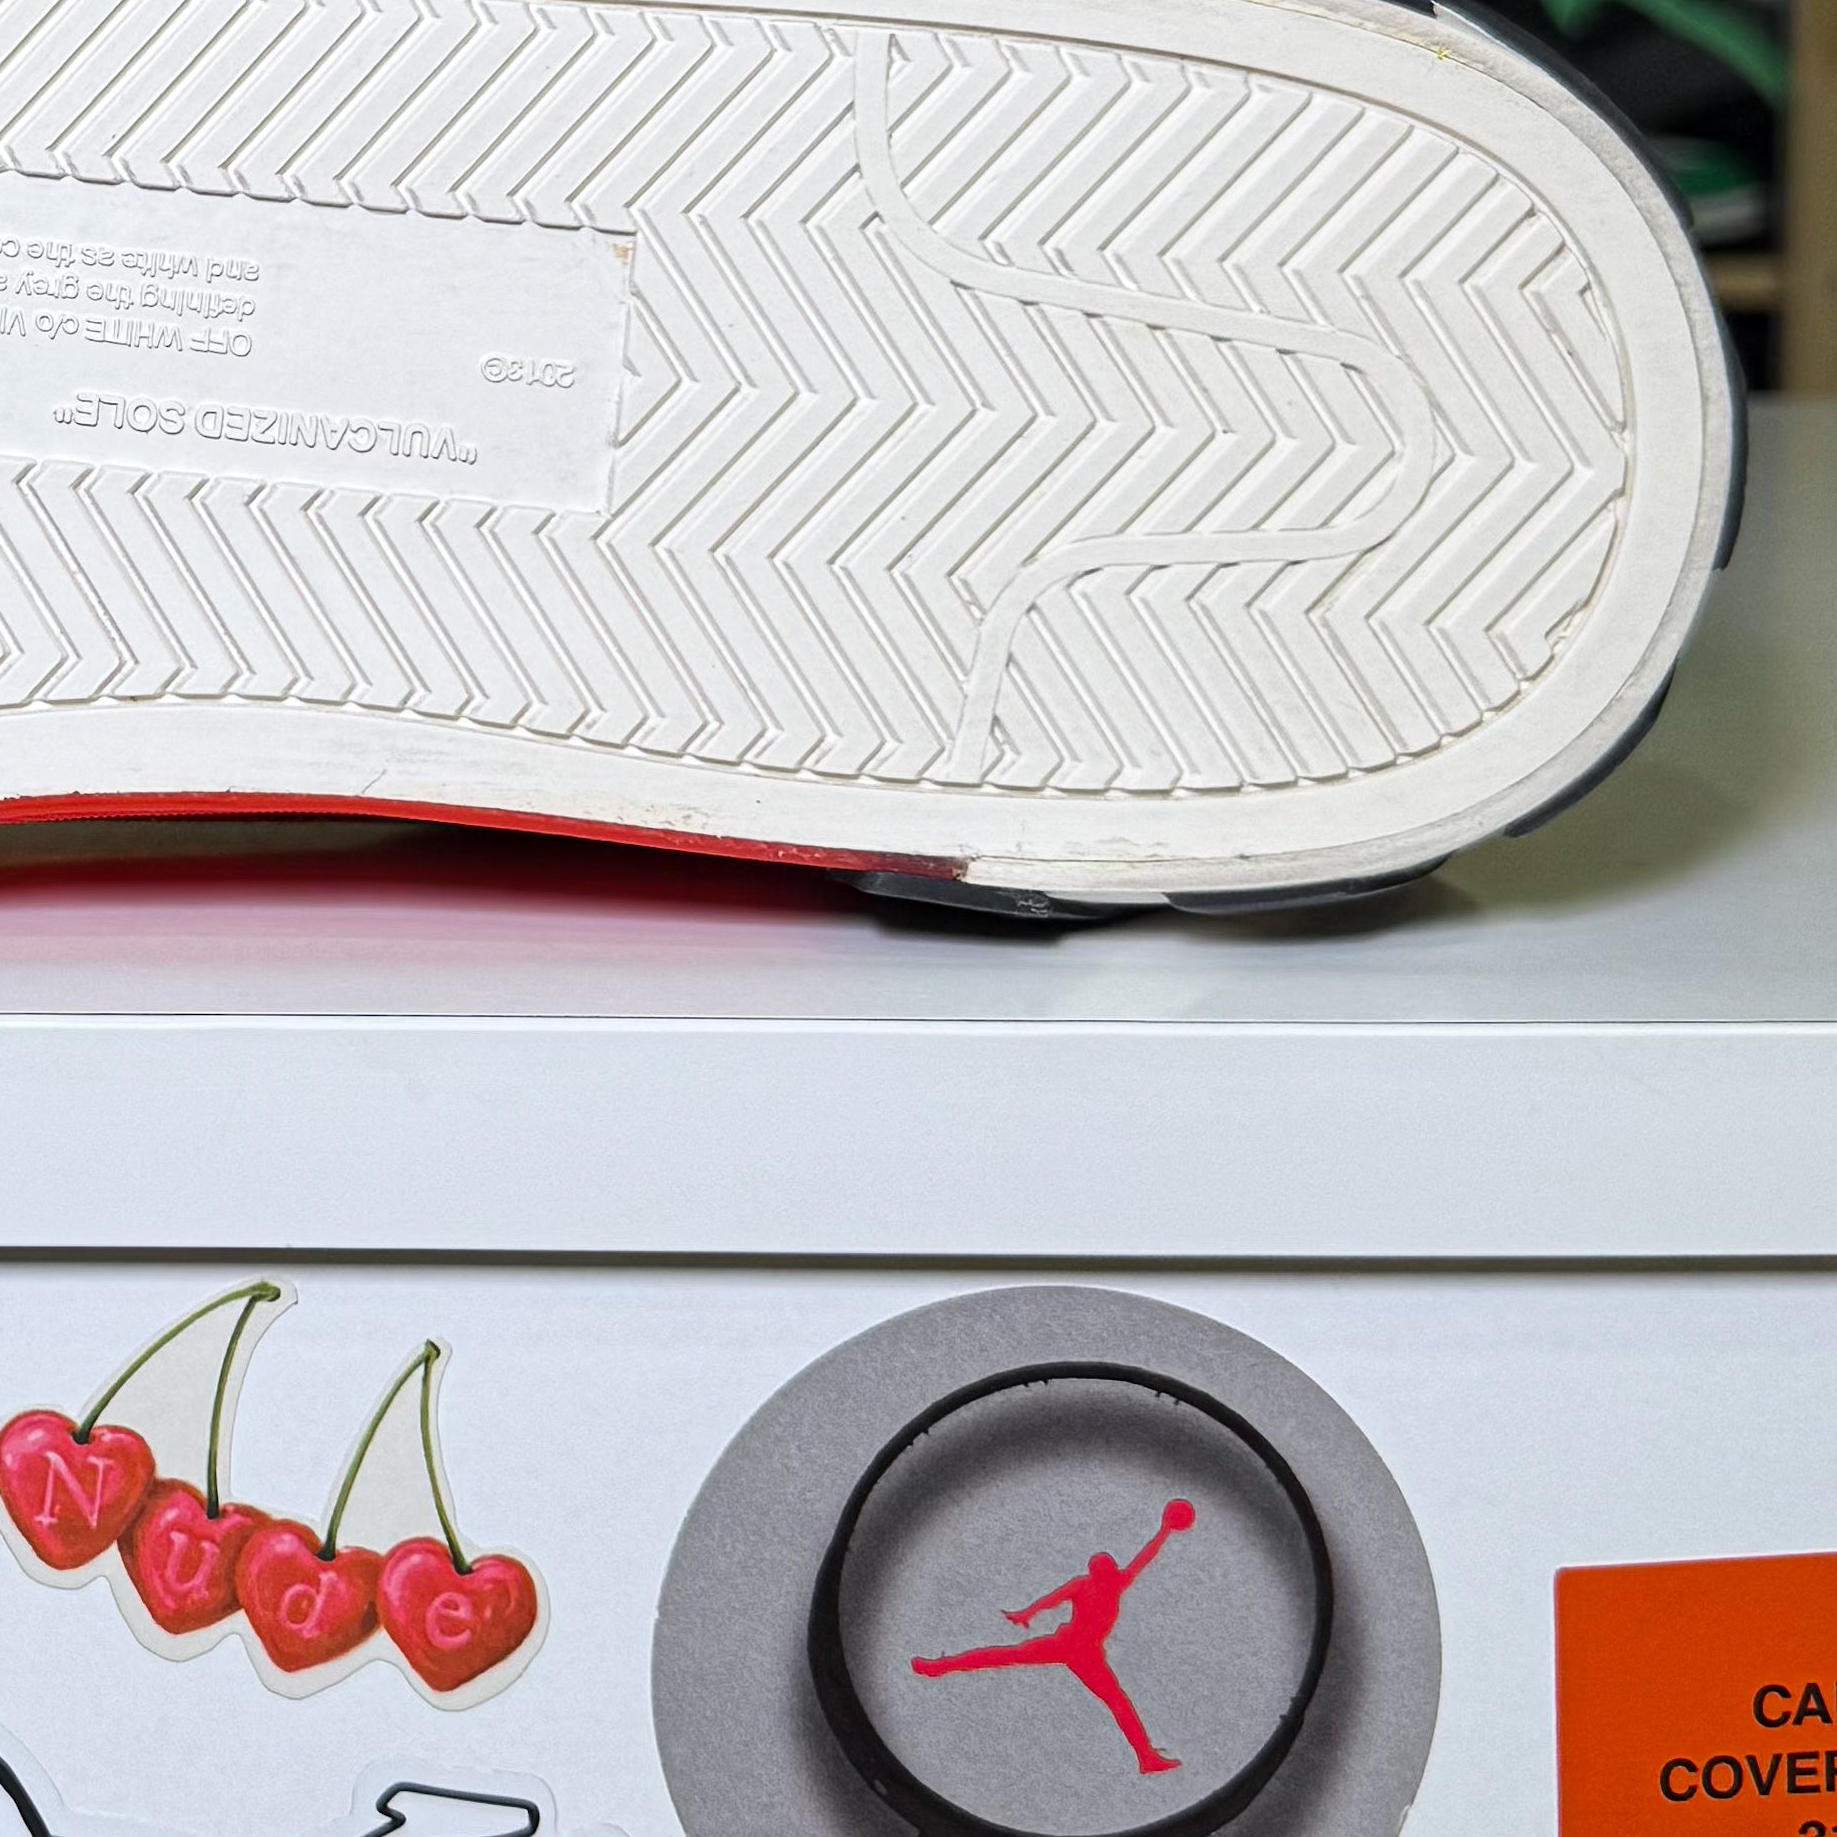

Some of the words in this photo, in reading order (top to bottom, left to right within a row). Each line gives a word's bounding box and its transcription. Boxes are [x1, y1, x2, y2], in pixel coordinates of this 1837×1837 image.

[27, 241, 75, 269] the
[81, 247, 115, 266] as
[121, 251, 198, 281] white
[15, 269, 80, 300] grey
[207, 258, 259, 283] and
[86, 282, 133, 310] the
[139, 283, 256, 319] defining
[35, 313, 79, 339] c/o
[84, 319, 183, 351] WHITE
[189, 328, 253, 357] OFF
[53, 393, 185, 437] SOLE"
[195, 404, 478, 465] "VULCANIZED
[1752, 1681, 1837, 1729] CA
